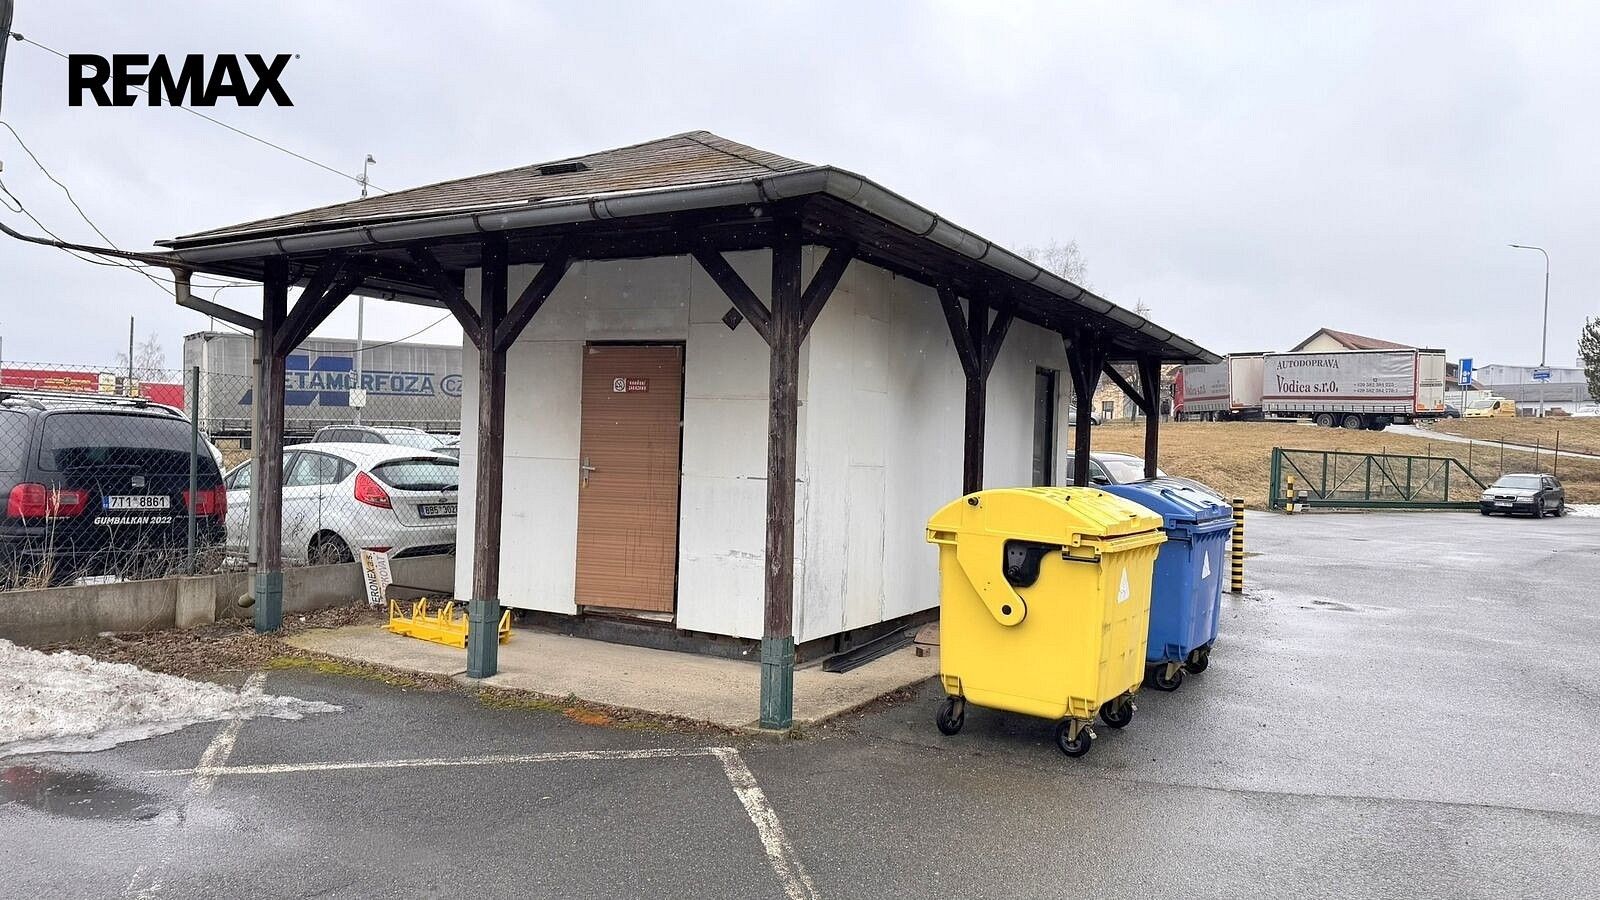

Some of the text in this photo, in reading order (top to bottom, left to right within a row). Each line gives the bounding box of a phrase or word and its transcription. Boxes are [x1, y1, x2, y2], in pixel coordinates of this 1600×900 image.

[1277, 359, 1339, 370] AUTODOPRAVA
[1276, 374, 1311, 393] Vodica
[111, 496, 132, 507] 7T1
[139, 496, 166, 507] 8861
[93, 515, 173, 526] GUMBALKAN 2022
